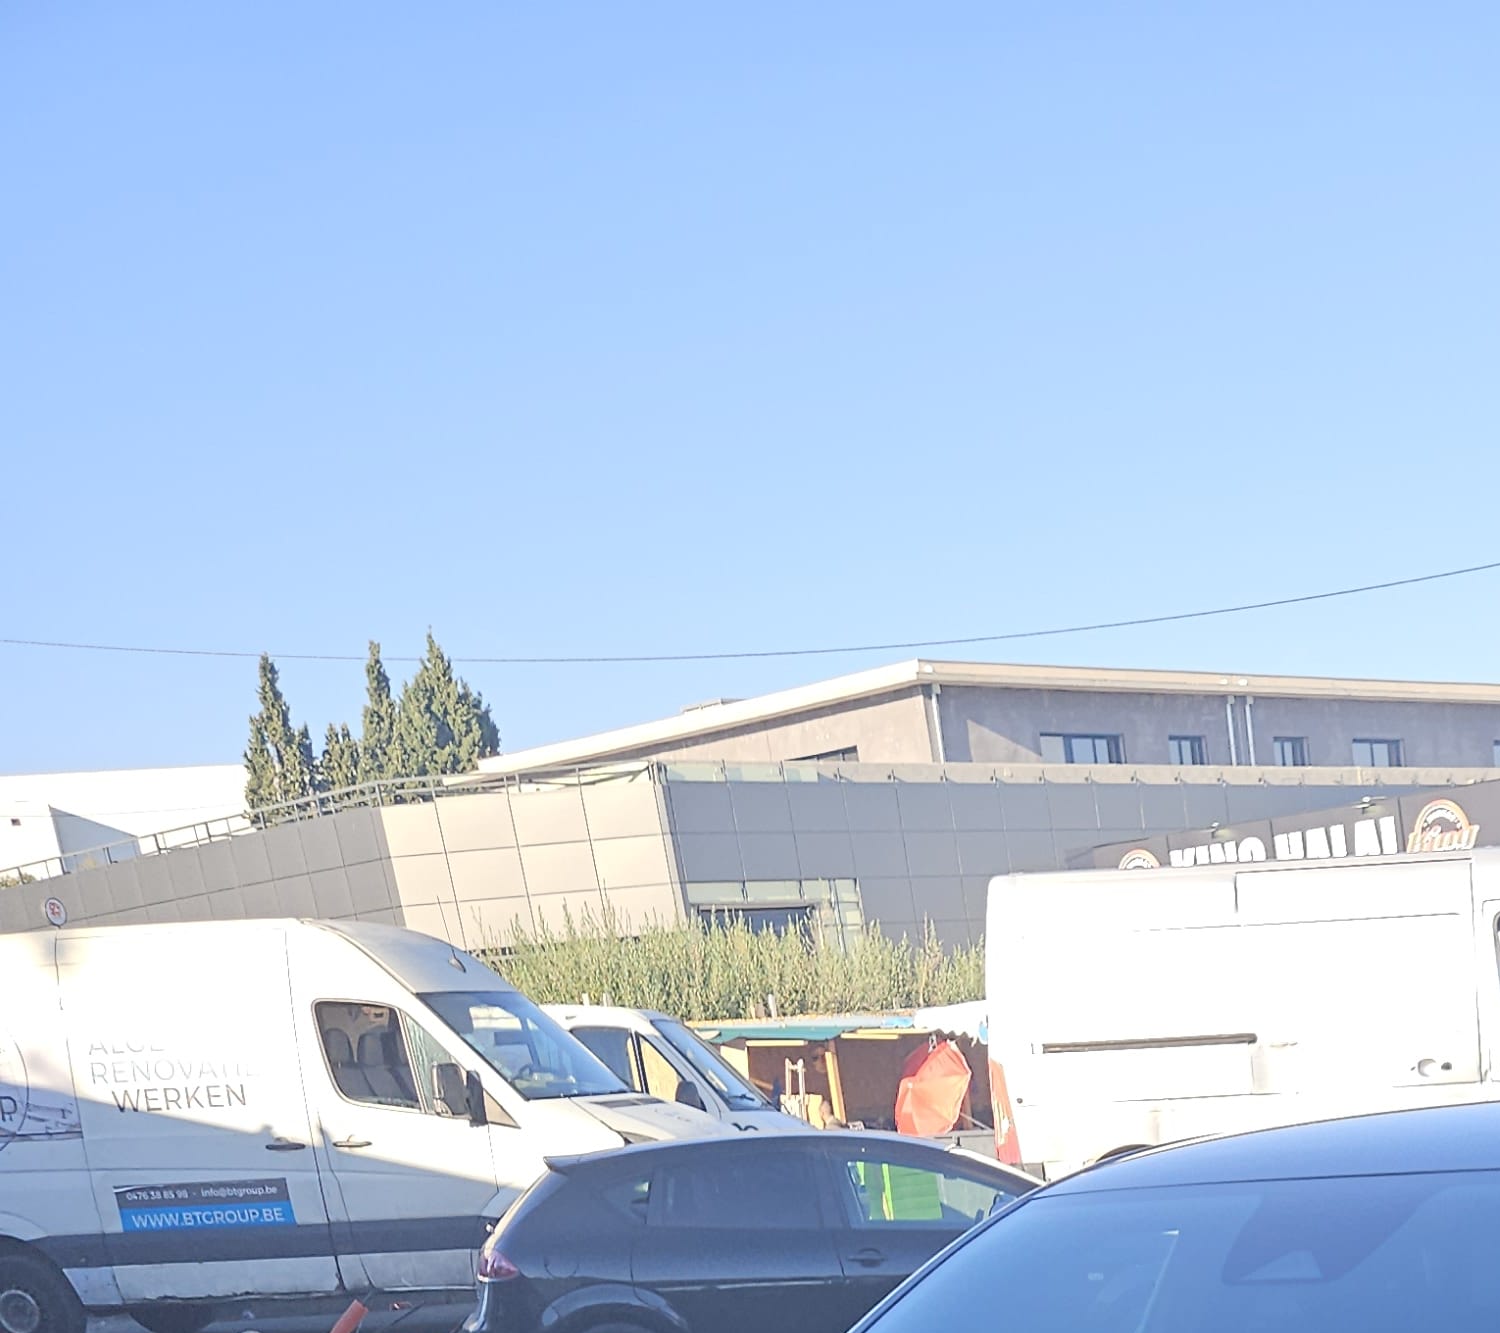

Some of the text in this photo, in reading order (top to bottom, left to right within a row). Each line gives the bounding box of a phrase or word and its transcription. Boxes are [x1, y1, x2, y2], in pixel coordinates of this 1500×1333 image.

[112, 1084, 247, 1113] WERKEN
[201, 1185, 278, 1198] info@btgroup.be
[131, 1208, 285, 1229] WWW.BTGROUP.BE
